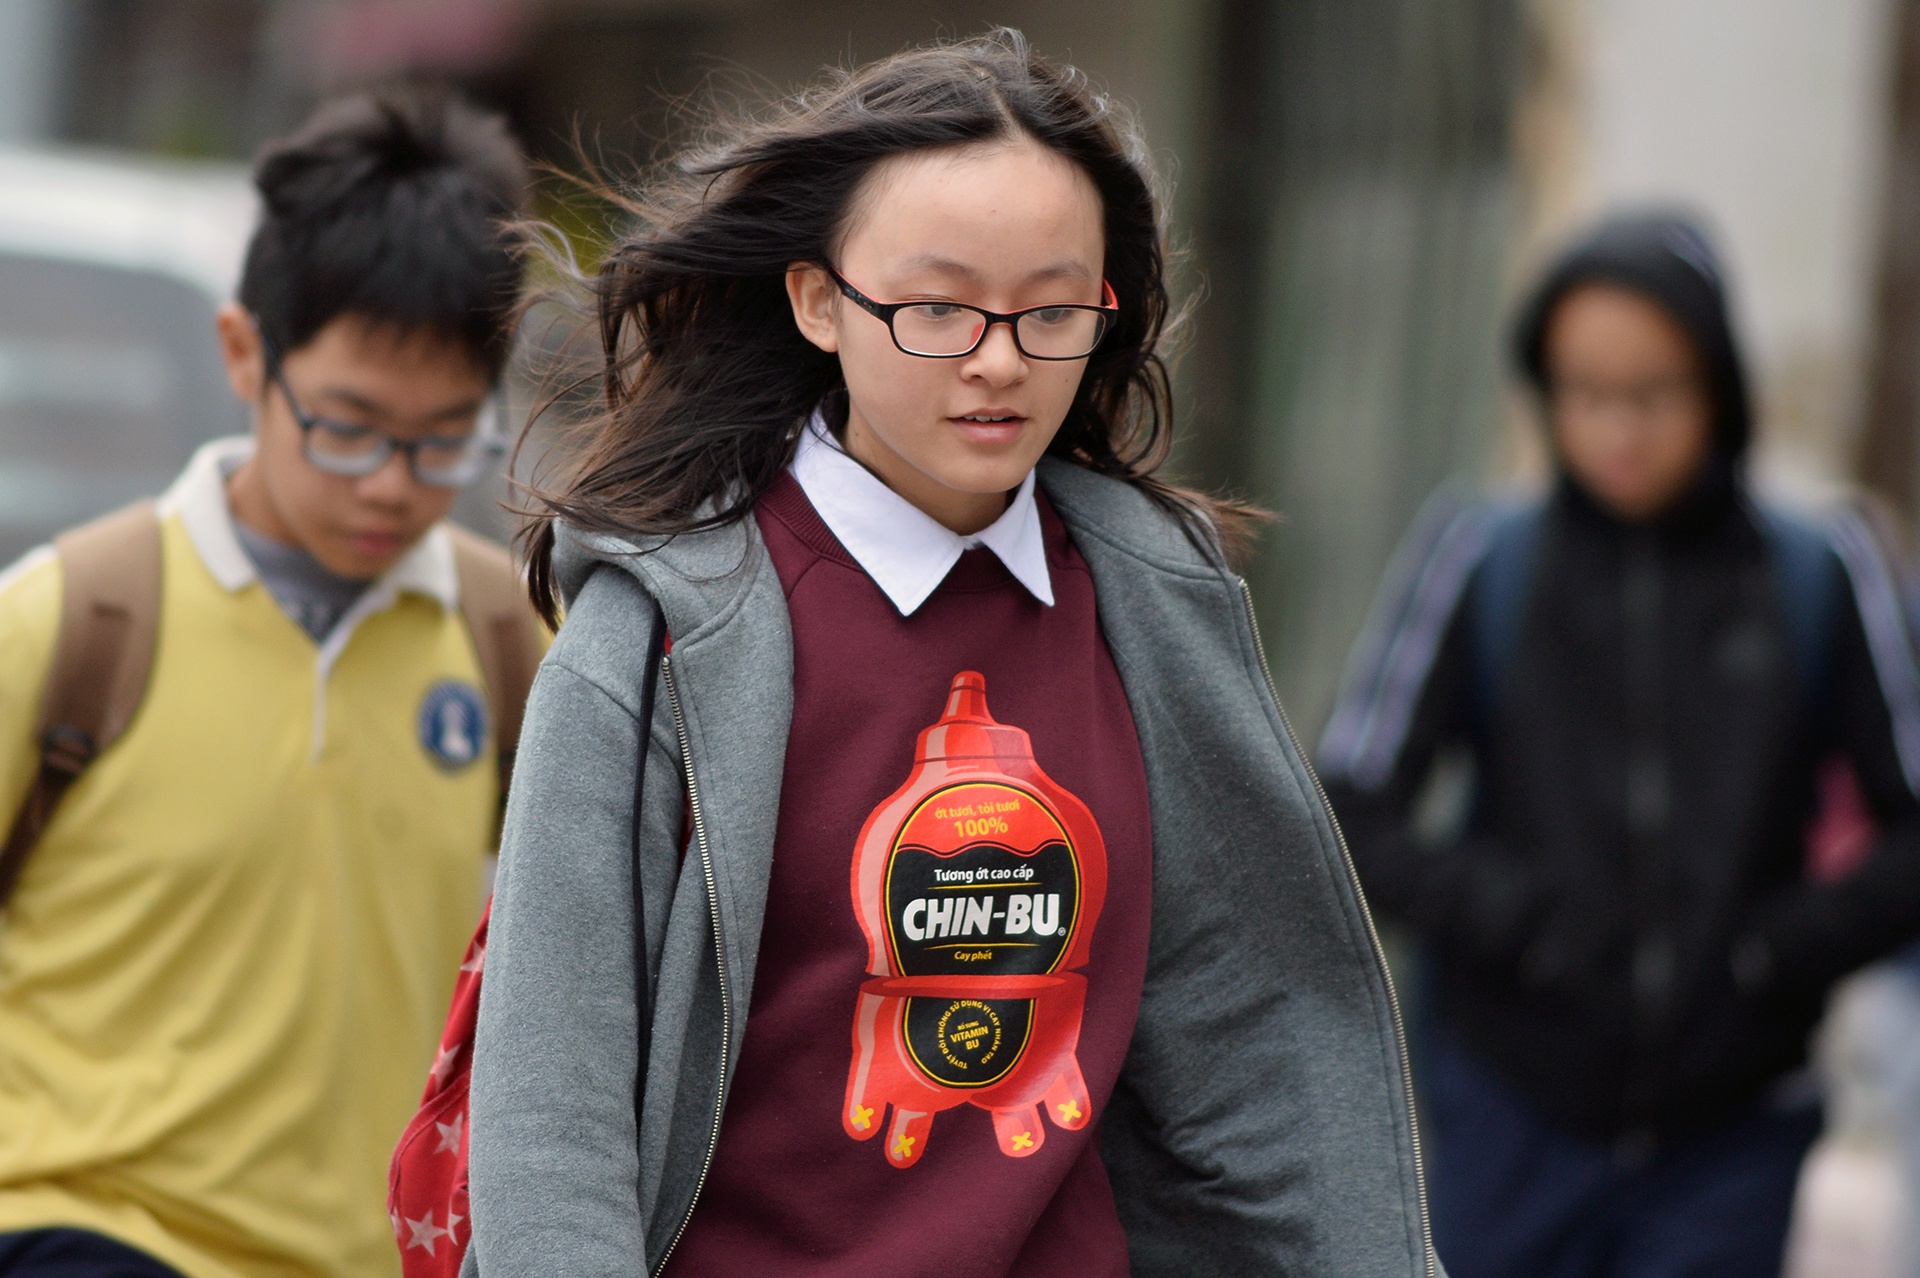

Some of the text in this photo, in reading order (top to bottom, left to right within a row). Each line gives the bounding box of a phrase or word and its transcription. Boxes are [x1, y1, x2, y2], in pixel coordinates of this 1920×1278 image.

[954, 815, 1008, 837] 100%
[934, 863, 1034, 883] Tương ớt cao cấp
[954, 949, 993, 962] Cay phết
[989, 1012, 1000, 1026] CAY
[950, 1026, 989, 1043] VITAMIN
[965, 1038, 980, 1050] BU
